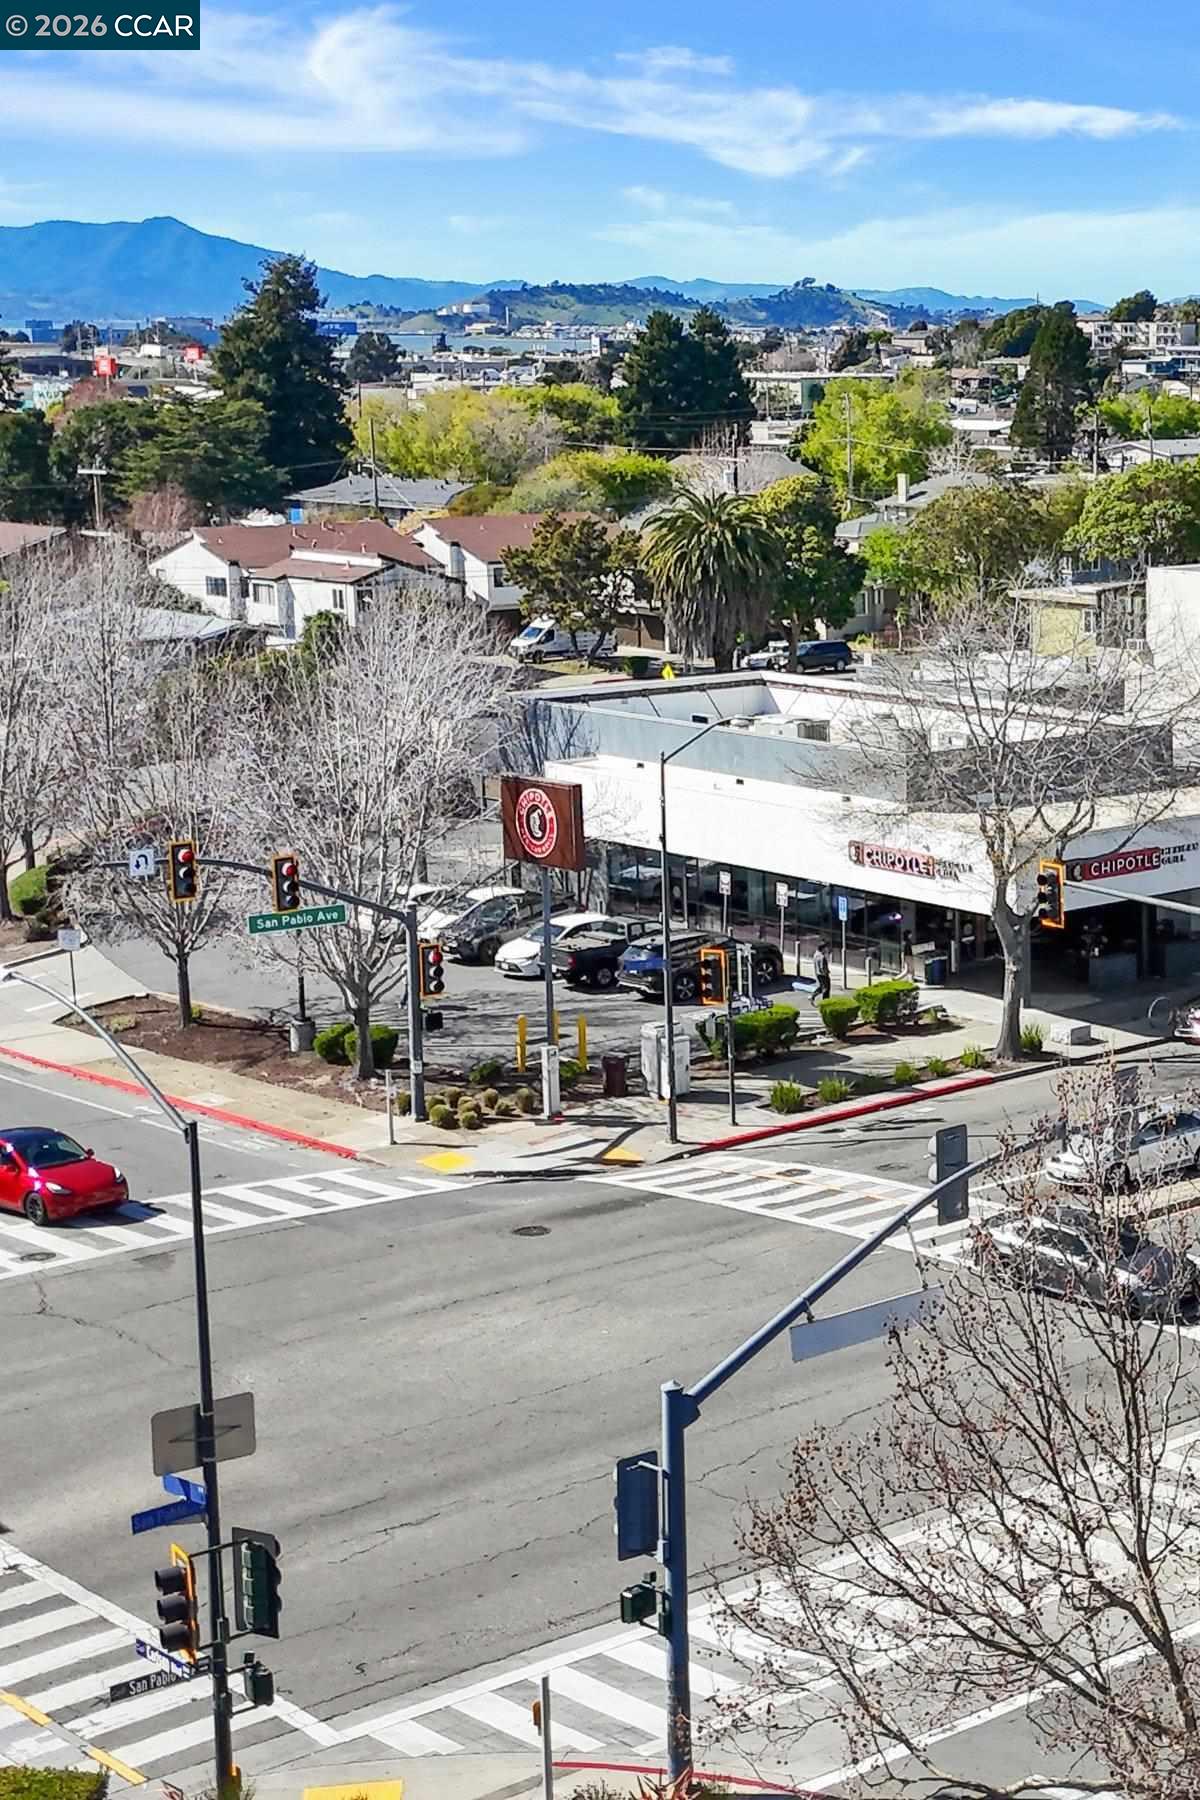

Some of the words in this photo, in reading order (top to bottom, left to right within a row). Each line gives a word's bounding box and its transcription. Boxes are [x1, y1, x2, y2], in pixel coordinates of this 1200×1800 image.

[866, 848, 931, 876] CHIPOTLE
[1090, 851, 1160, 876] CHIPOTLE
[256, 918, 278, 930] San
[282, 914, 313, 926] Pablo
[317, 911, 338, 922] Ave
[129, 1676, 148, 1697] San
